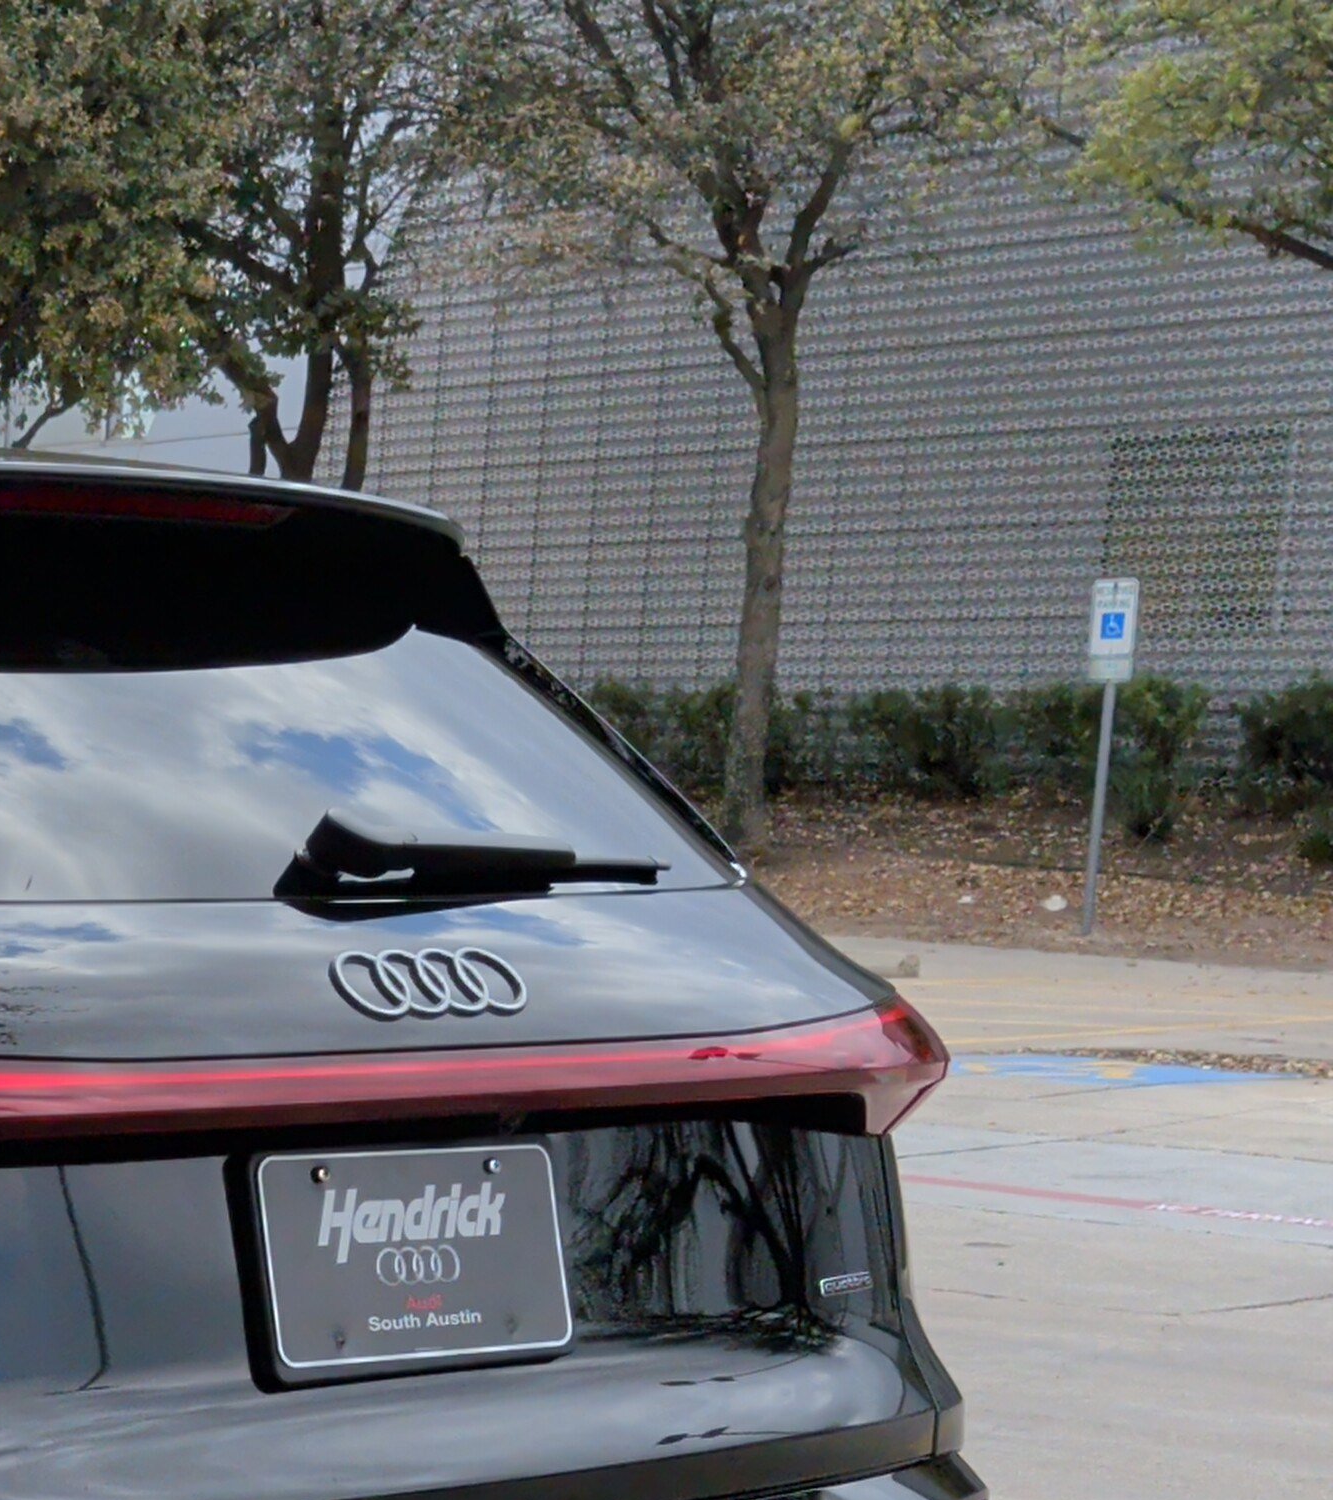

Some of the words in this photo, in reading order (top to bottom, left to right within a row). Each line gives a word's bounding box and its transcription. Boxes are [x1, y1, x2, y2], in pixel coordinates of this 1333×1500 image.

[318, 1182, 506, 1264] Hendrick
[407, 1294, 442, 1311] Audi
[368, 1314, 421, 1332] South
[426, 1309, 482, 1328] Austin
